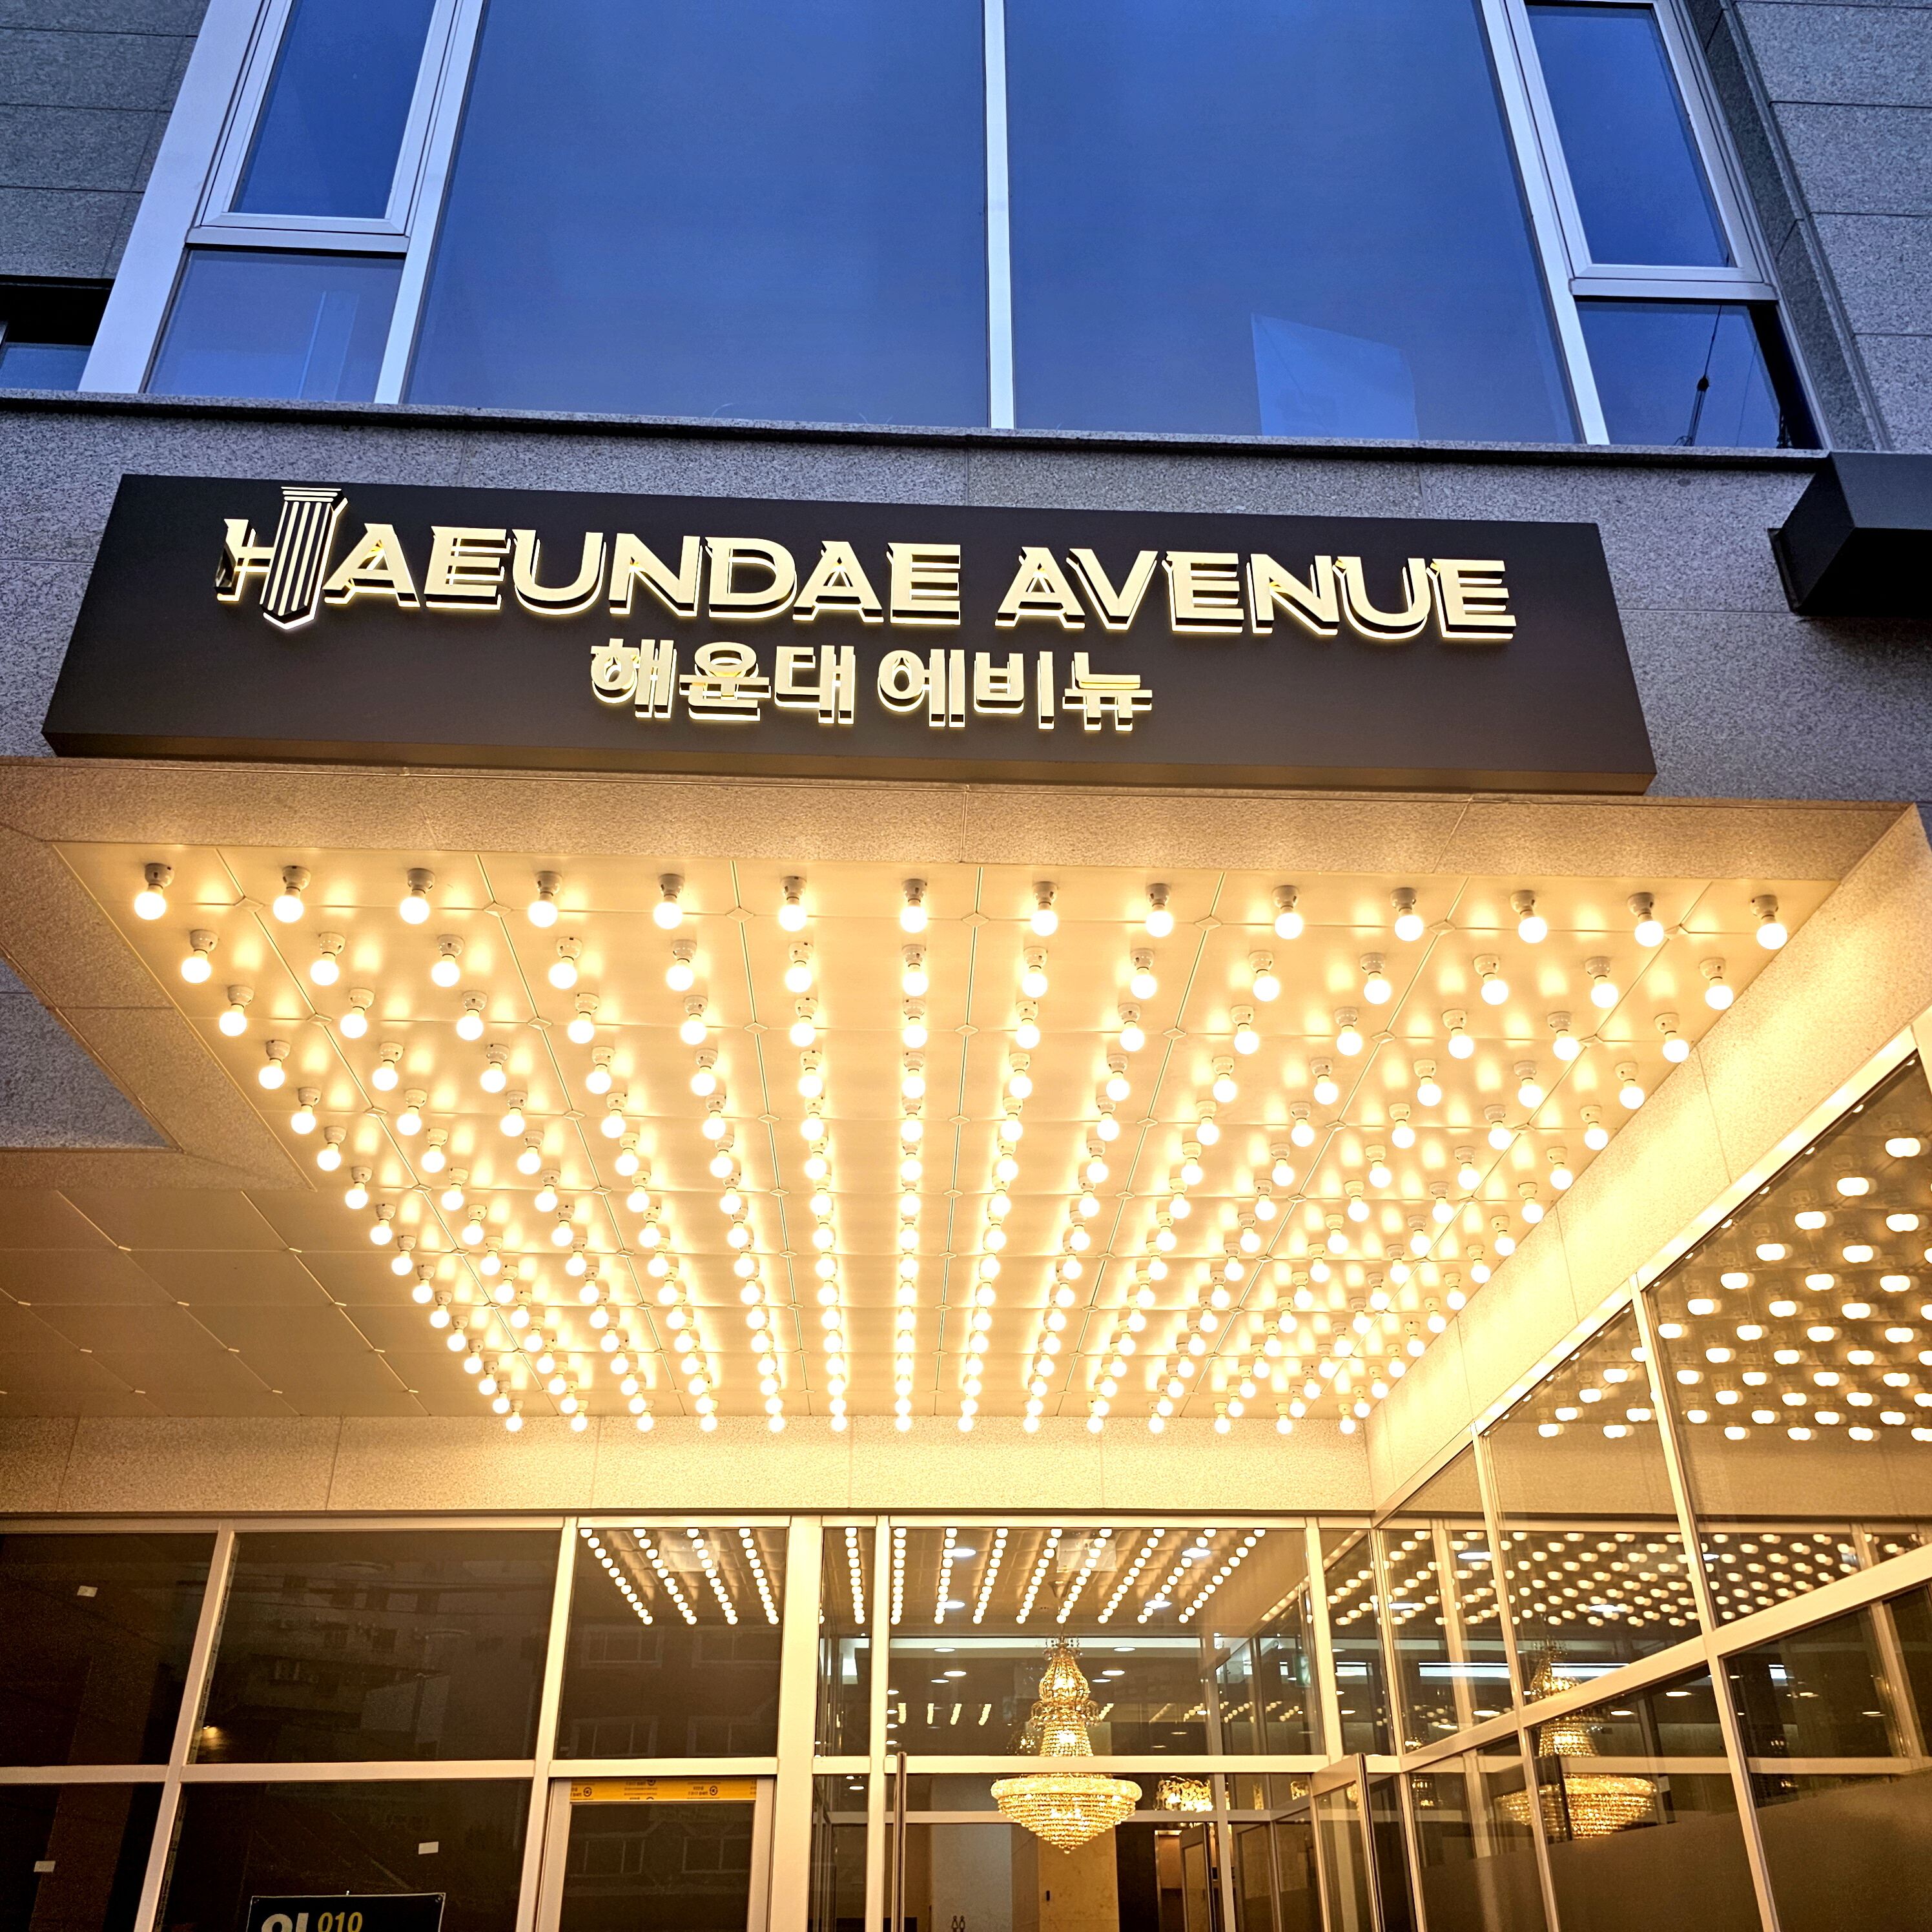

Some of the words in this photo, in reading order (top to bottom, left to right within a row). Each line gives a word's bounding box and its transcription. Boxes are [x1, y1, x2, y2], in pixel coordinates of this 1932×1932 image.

[216, 486, 961, 630] HAEUNDAE
[995, 546, 1517, 640] AVENUE
[590, 638, 858, 724] 해운대
[877, 648, 1153, 732] 에비뉴
[317, 1911, 363, 1932] 010
